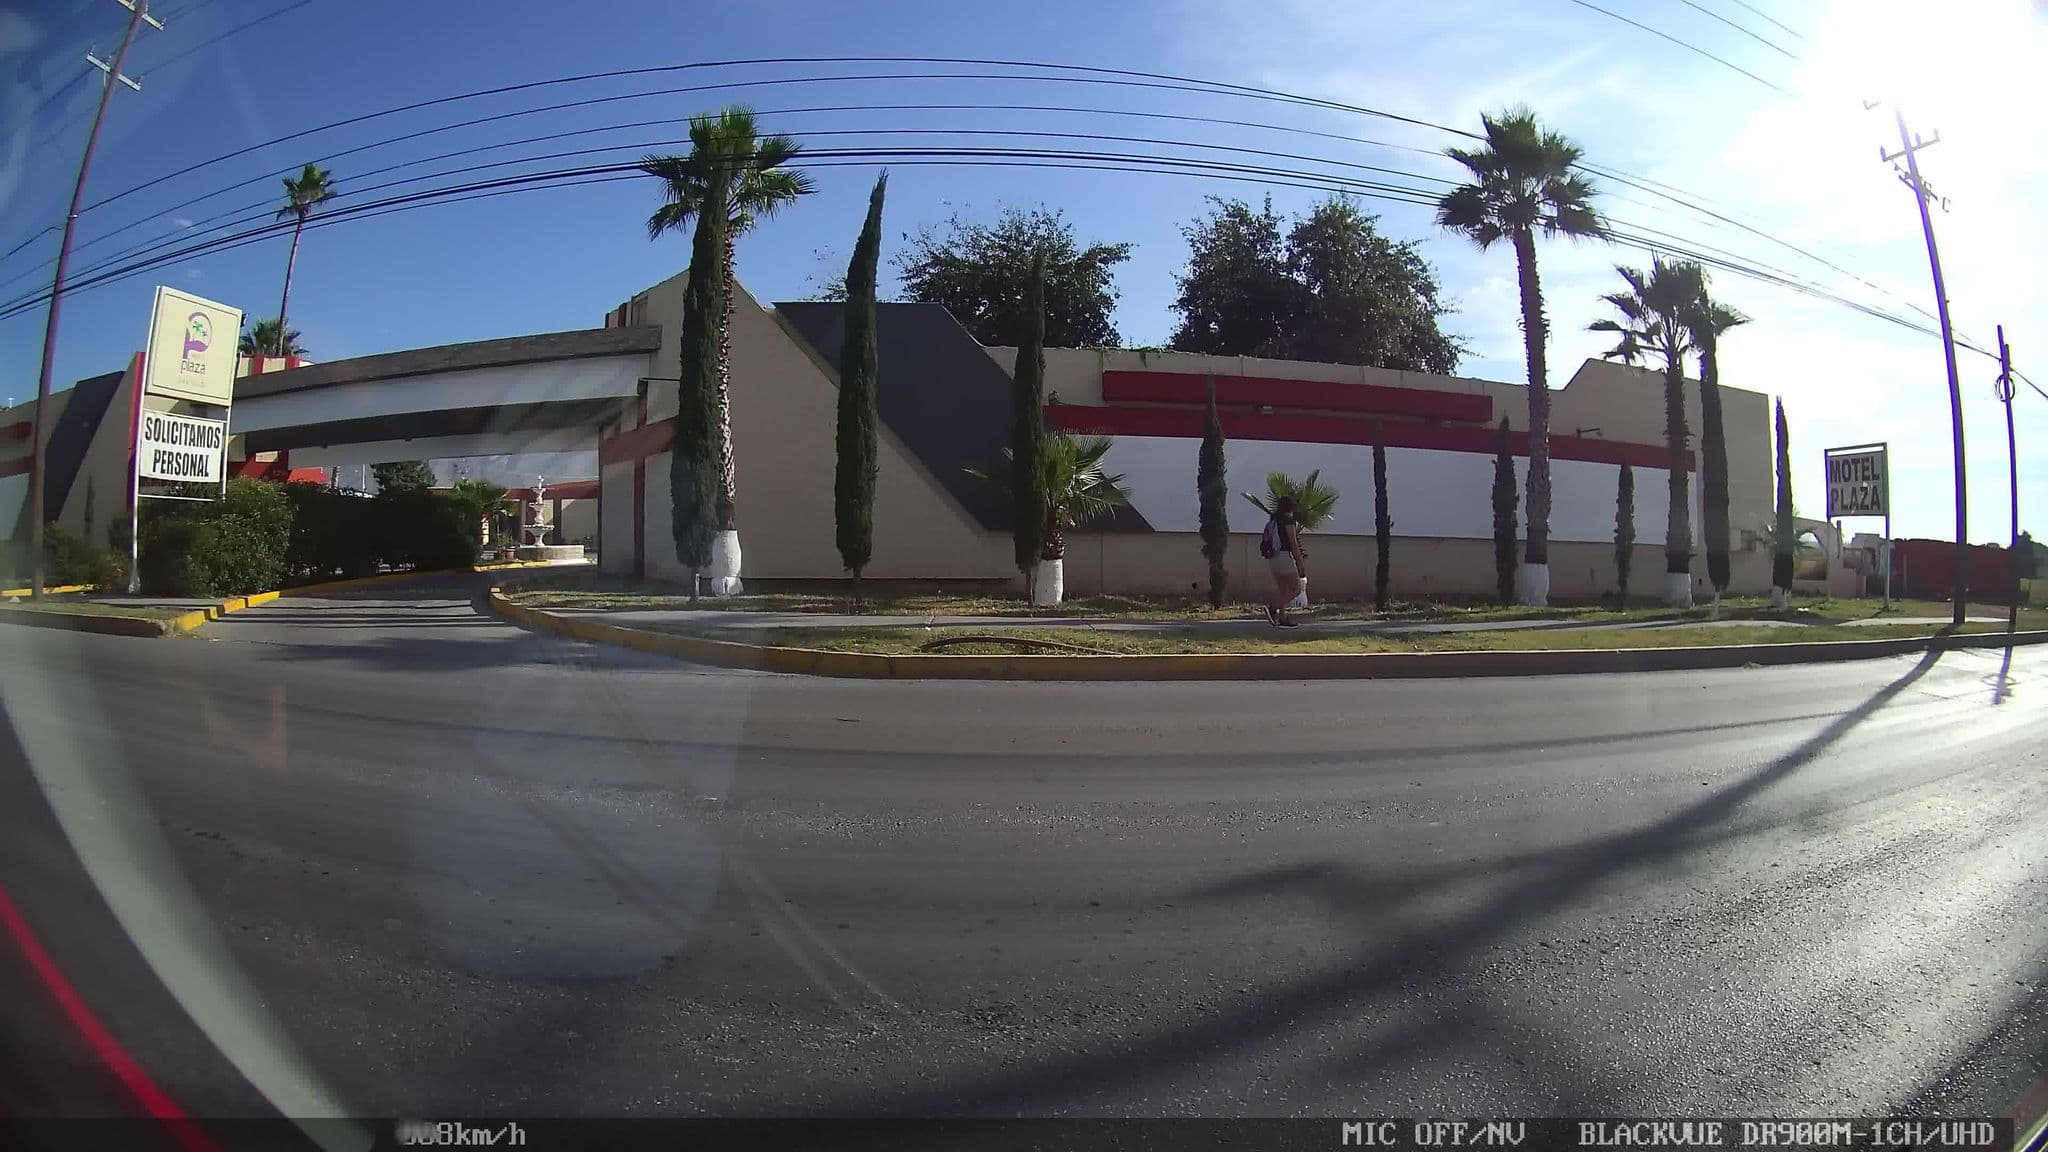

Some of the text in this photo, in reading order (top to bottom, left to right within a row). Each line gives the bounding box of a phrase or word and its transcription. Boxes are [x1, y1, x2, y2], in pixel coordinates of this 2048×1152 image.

[180, 358, 206, 375] plaza
[145, 416, 221, 449] SOLICITAMOS
[152, 449, 209, 477] PERSONAL
[1829, 456, 1880, 483] MOTEL
[1830, 485, 1880, 512] PLAZA
